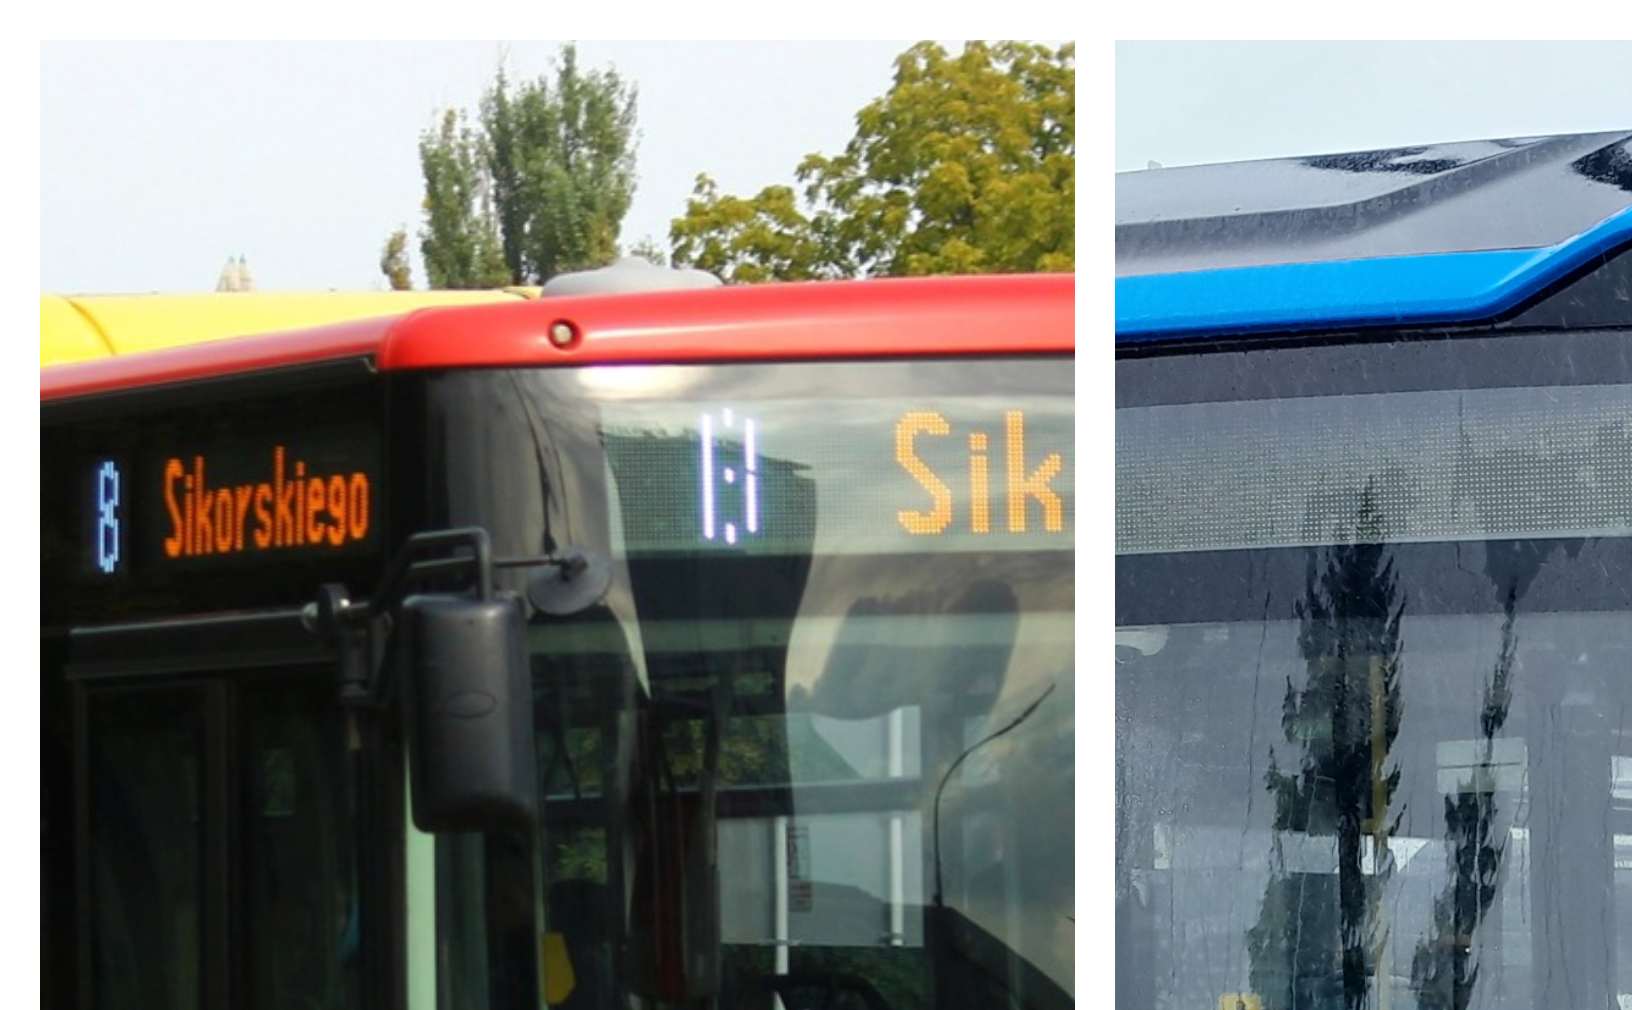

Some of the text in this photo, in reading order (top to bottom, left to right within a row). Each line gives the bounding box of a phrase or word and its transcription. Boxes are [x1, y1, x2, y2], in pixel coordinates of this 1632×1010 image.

[99, 445, 369, 573] 8 Sikorskiego
[895, 409, 1063, 535] Sik
